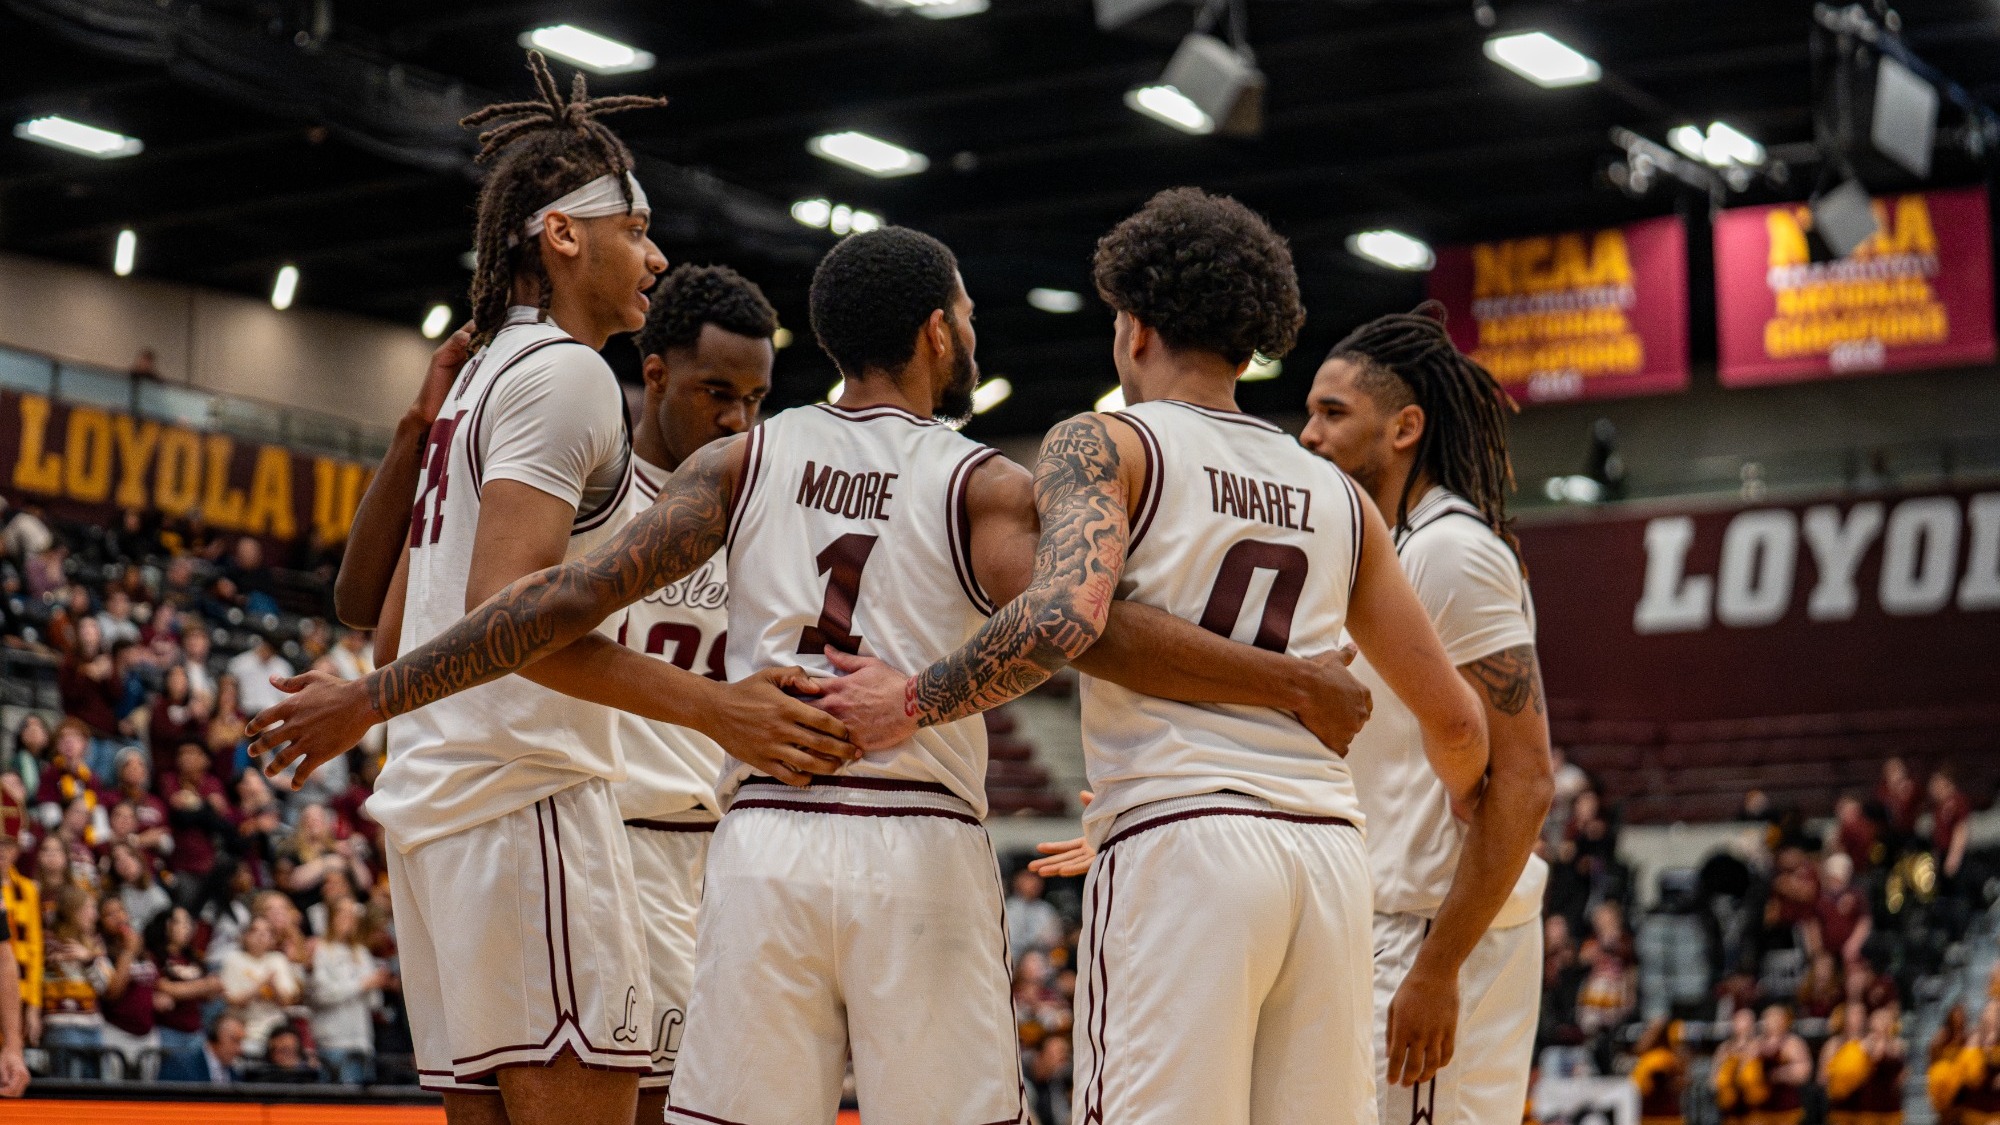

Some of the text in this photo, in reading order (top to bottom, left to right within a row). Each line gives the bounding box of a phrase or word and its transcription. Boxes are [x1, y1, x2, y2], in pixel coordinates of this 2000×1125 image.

[13, 392, 297, 541] LOYOLA
[796, 460, 899, 521] MOORE
[1203, 466, 1315, 533] TAVAREZ
[796, 532, 879, 655] 1
[1198, 538, 1309, 654] 0
[378, 641, 485, 721] Chosen
